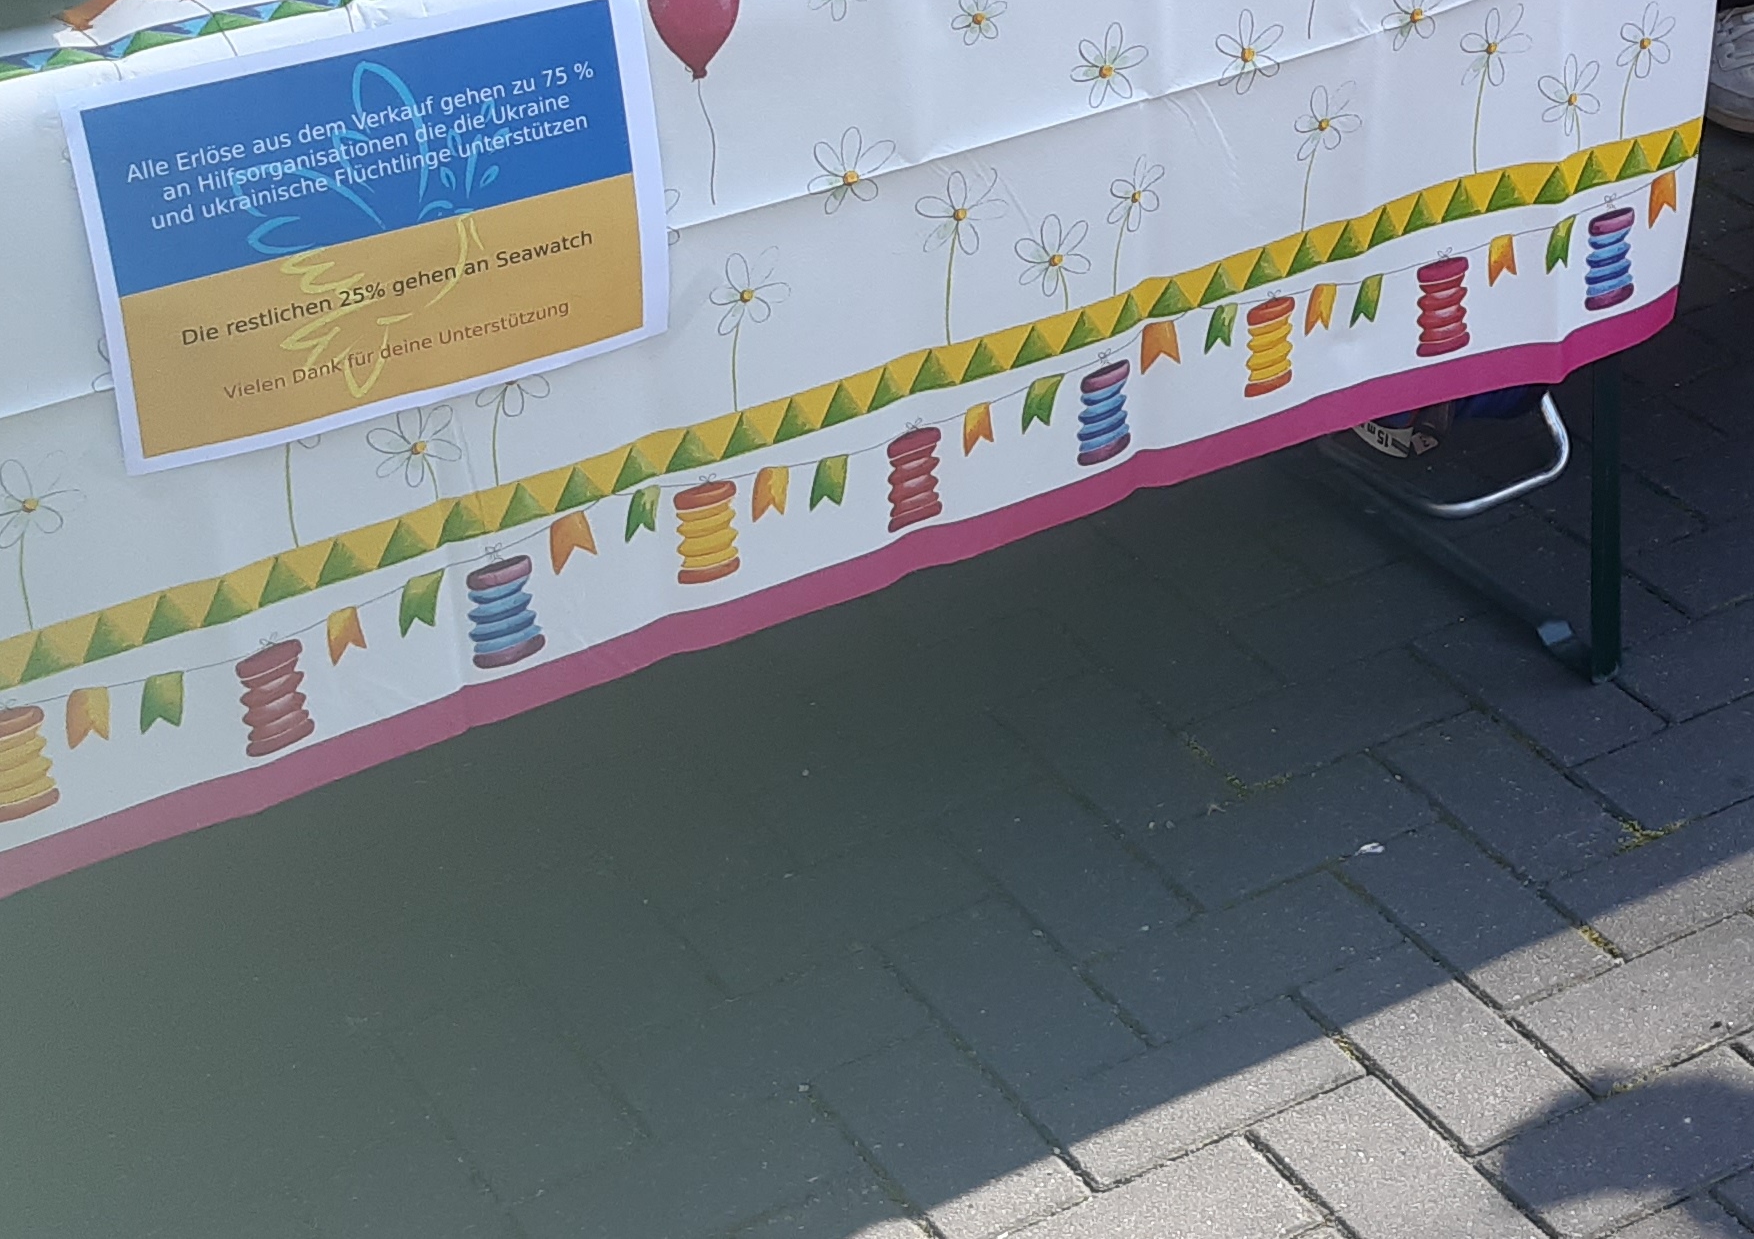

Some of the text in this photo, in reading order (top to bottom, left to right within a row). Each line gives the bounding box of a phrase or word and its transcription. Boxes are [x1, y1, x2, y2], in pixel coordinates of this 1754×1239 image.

[127, 61, 594, 183] Alle Erlöse aus dem Verkauf gehen zu 75 %
[151, 115, 588, 230] und ukrainische Flüchtlinge unterstützen
[162, 94, 570, 201] an Hilfsorganisationen die die Ukraine
[182, 230, 593, 346] Die restlichen 25% gehen an Seawatch
[224, 302, 569, 399] Vielen Dank für deine Unterstützung
[1376, 429, 1389, 447] 15
